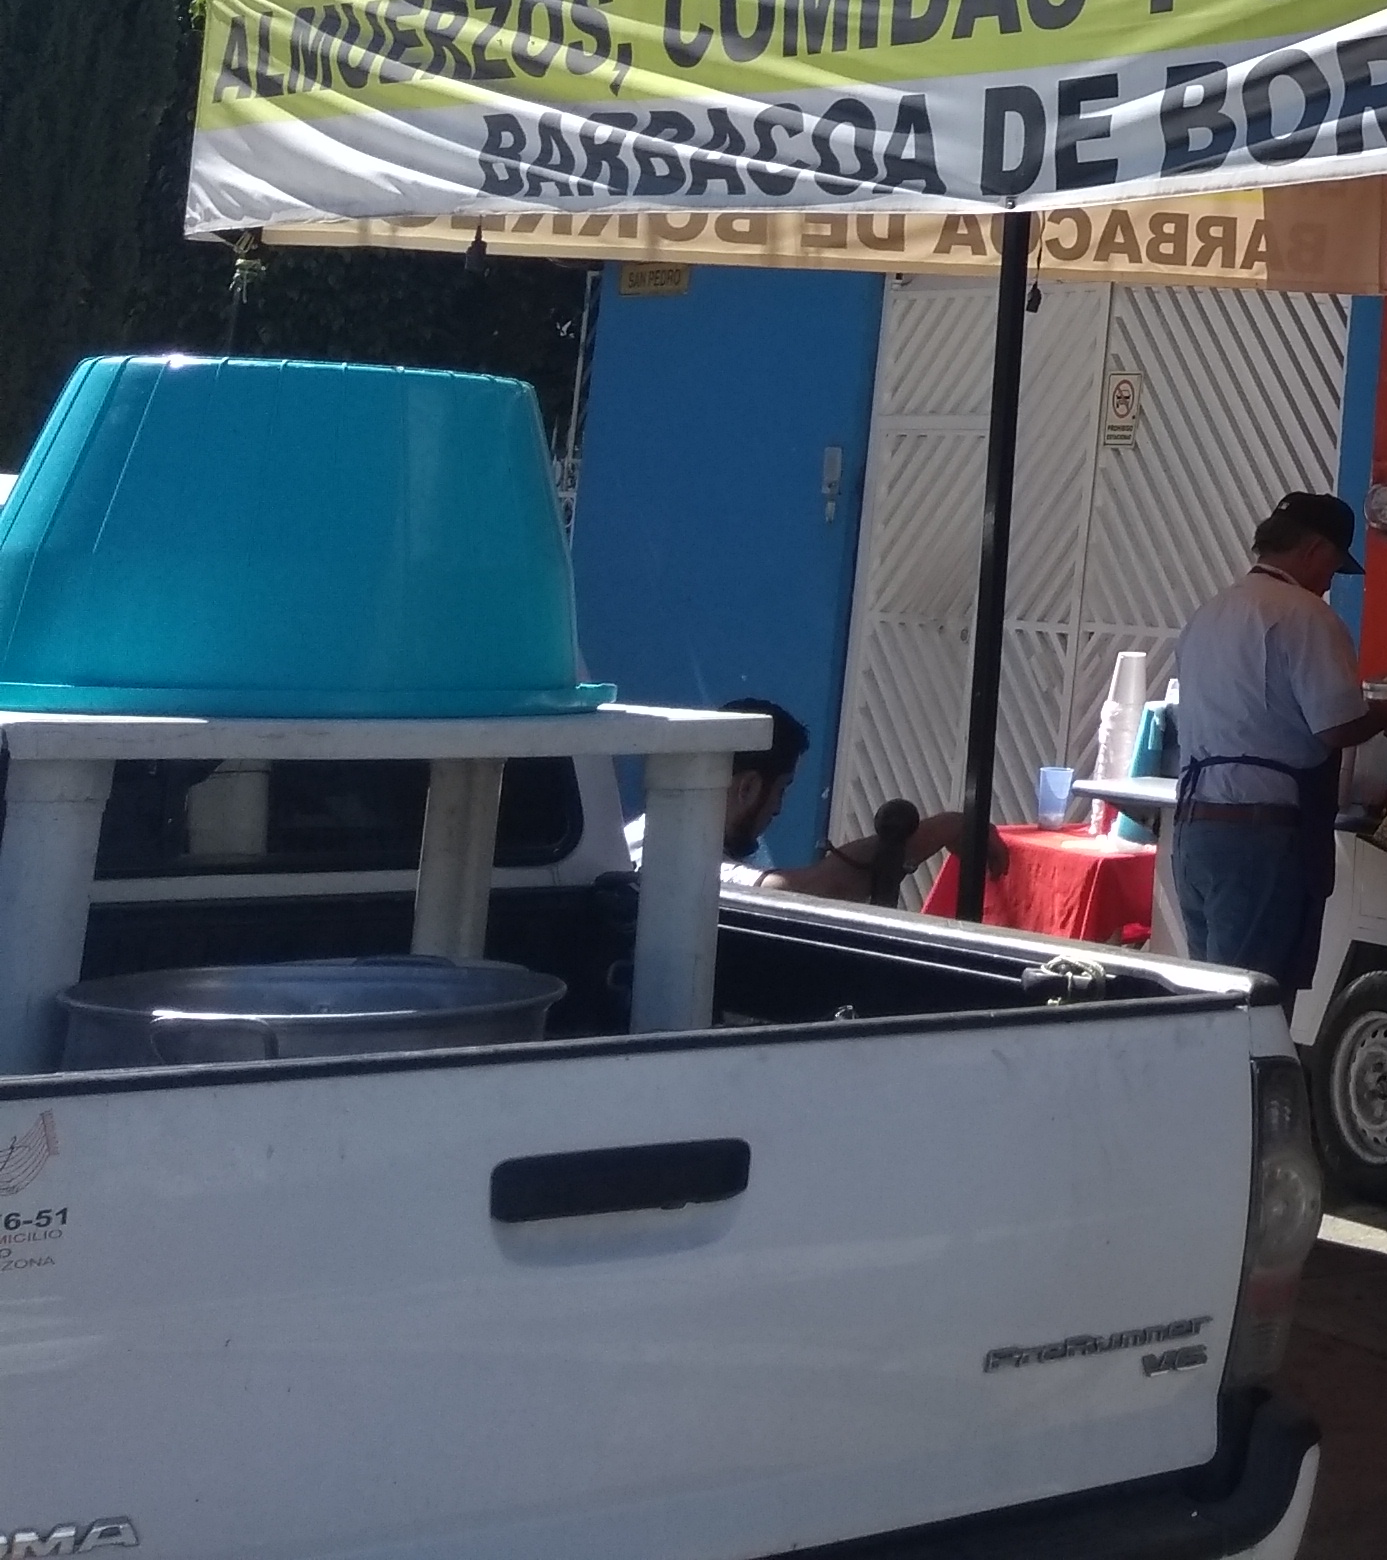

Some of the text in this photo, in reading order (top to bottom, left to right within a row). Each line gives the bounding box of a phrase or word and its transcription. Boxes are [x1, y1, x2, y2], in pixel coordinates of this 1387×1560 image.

[476, 86, 946, 202] BARBACOA
[978, 72, 1121, 199] DE
[627, 268, 681, 289] SAN PEDRO
